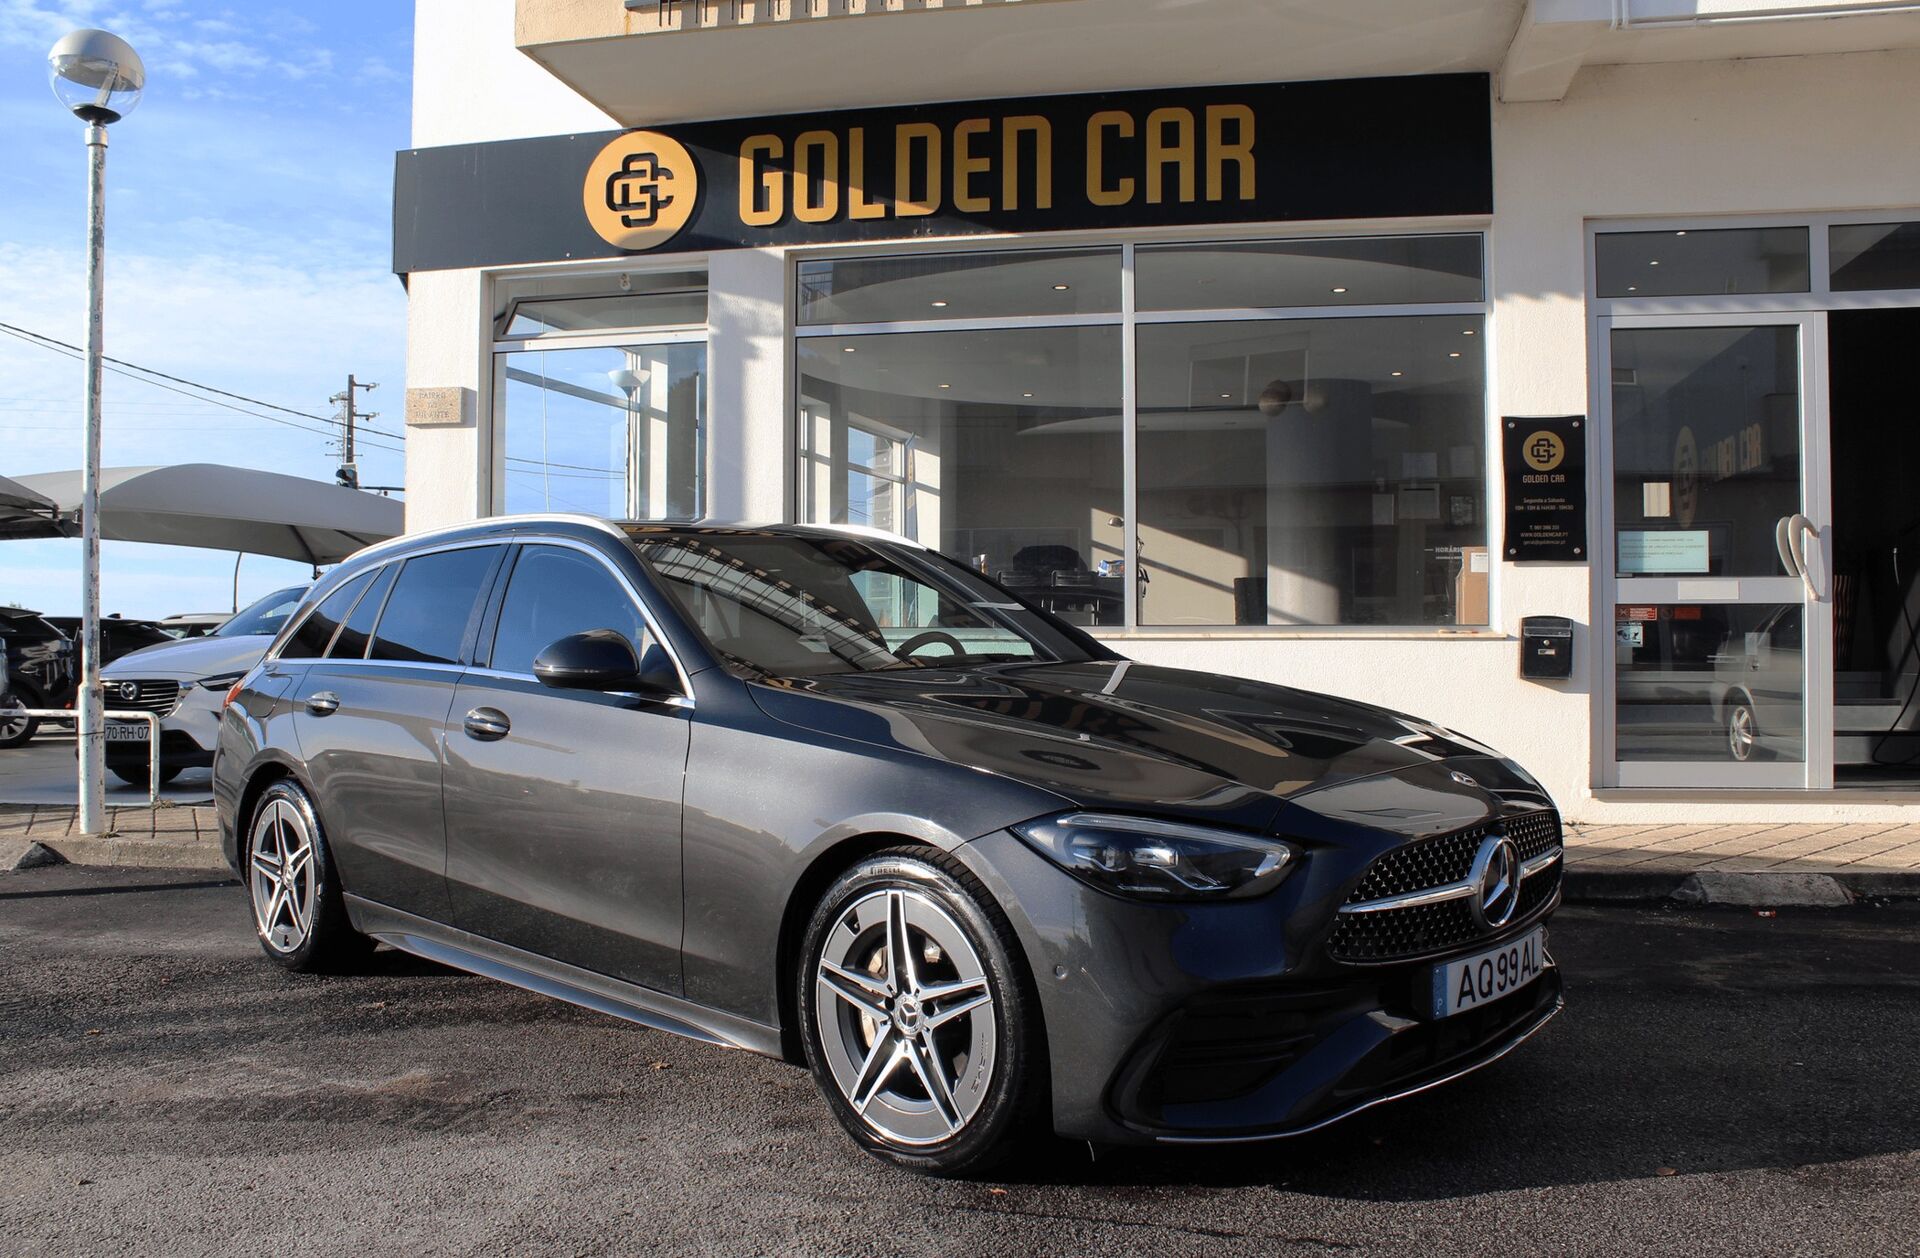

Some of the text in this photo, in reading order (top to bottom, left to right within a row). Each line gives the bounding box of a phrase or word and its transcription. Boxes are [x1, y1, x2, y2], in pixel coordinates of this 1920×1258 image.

[739, 104, 1256, 226] GOLDEN CAR
[1522, 474, 1565, 483] GOLDEN CAR
